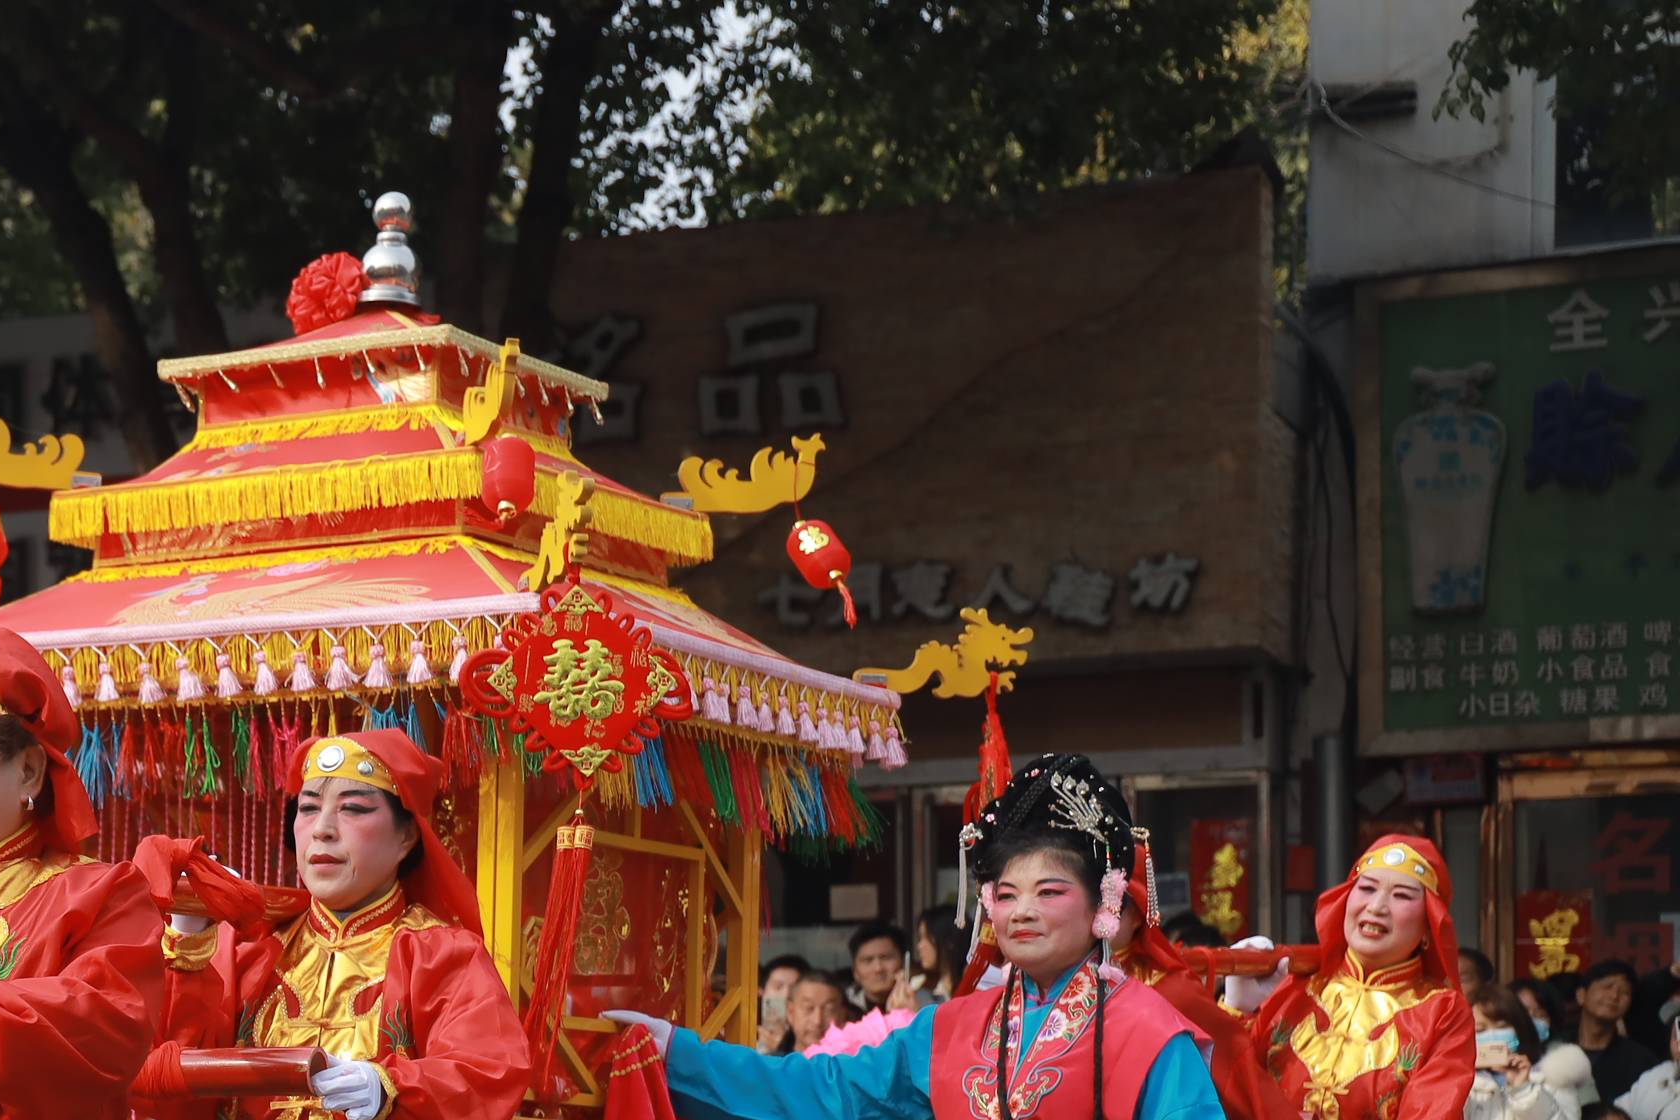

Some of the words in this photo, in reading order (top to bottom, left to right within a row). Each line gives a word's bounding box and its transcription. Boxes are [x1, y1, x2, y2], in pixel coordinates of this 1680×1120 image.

[1459, 629, 1518, 656] 白酒
[1536, 622, 1628, 652] 葡萄酒
[1459, 659, 1520, 687] 牛奶
[1536, 653, 1628, 682] 小食品
[1559, 684, 1618, 713] 糖果
